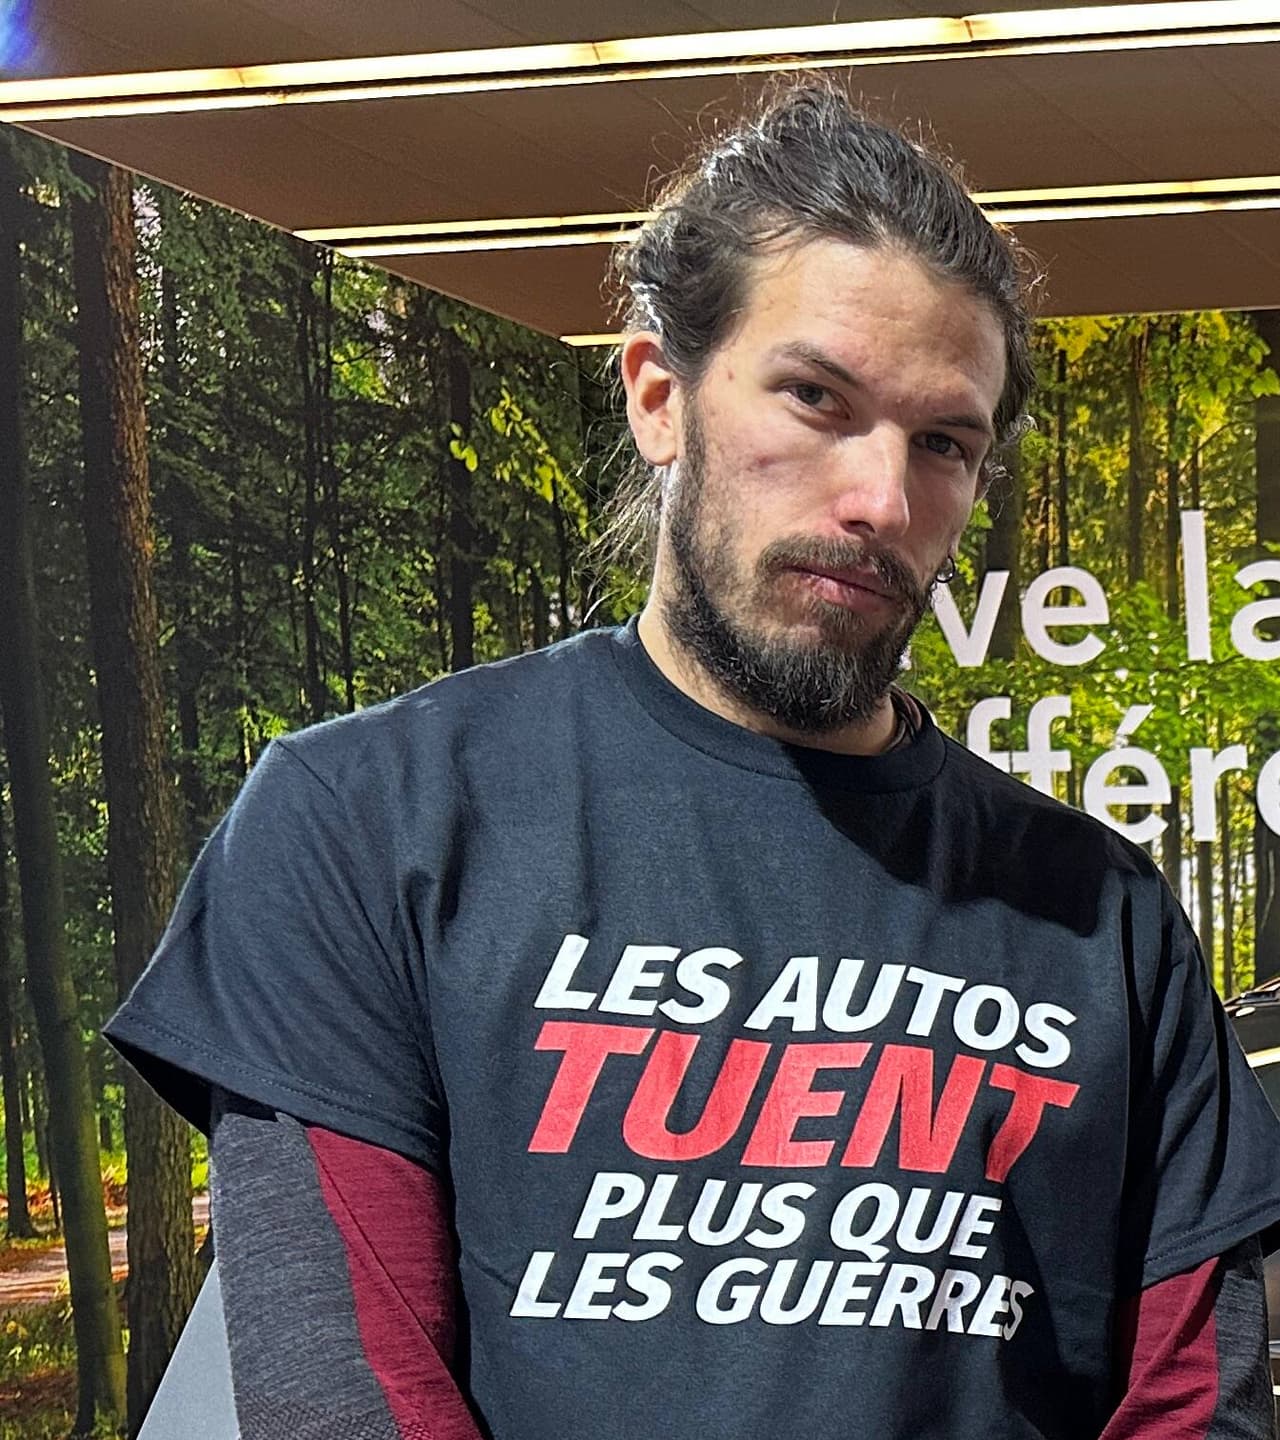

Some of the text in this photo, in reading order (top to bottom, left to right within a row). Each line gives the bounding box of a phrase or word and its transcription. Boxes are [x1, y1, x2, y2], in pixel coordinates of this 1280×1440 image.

[931, 566, 1111, 668] ve
[533, 933, 1078, 1069] LES AUTOS
[527, 1020, 1081, 1184] TUENT
[572, 1172, 1002, 1262] PLUS QUE
[509, 1251, 1036, 1341] LES GUERRES
